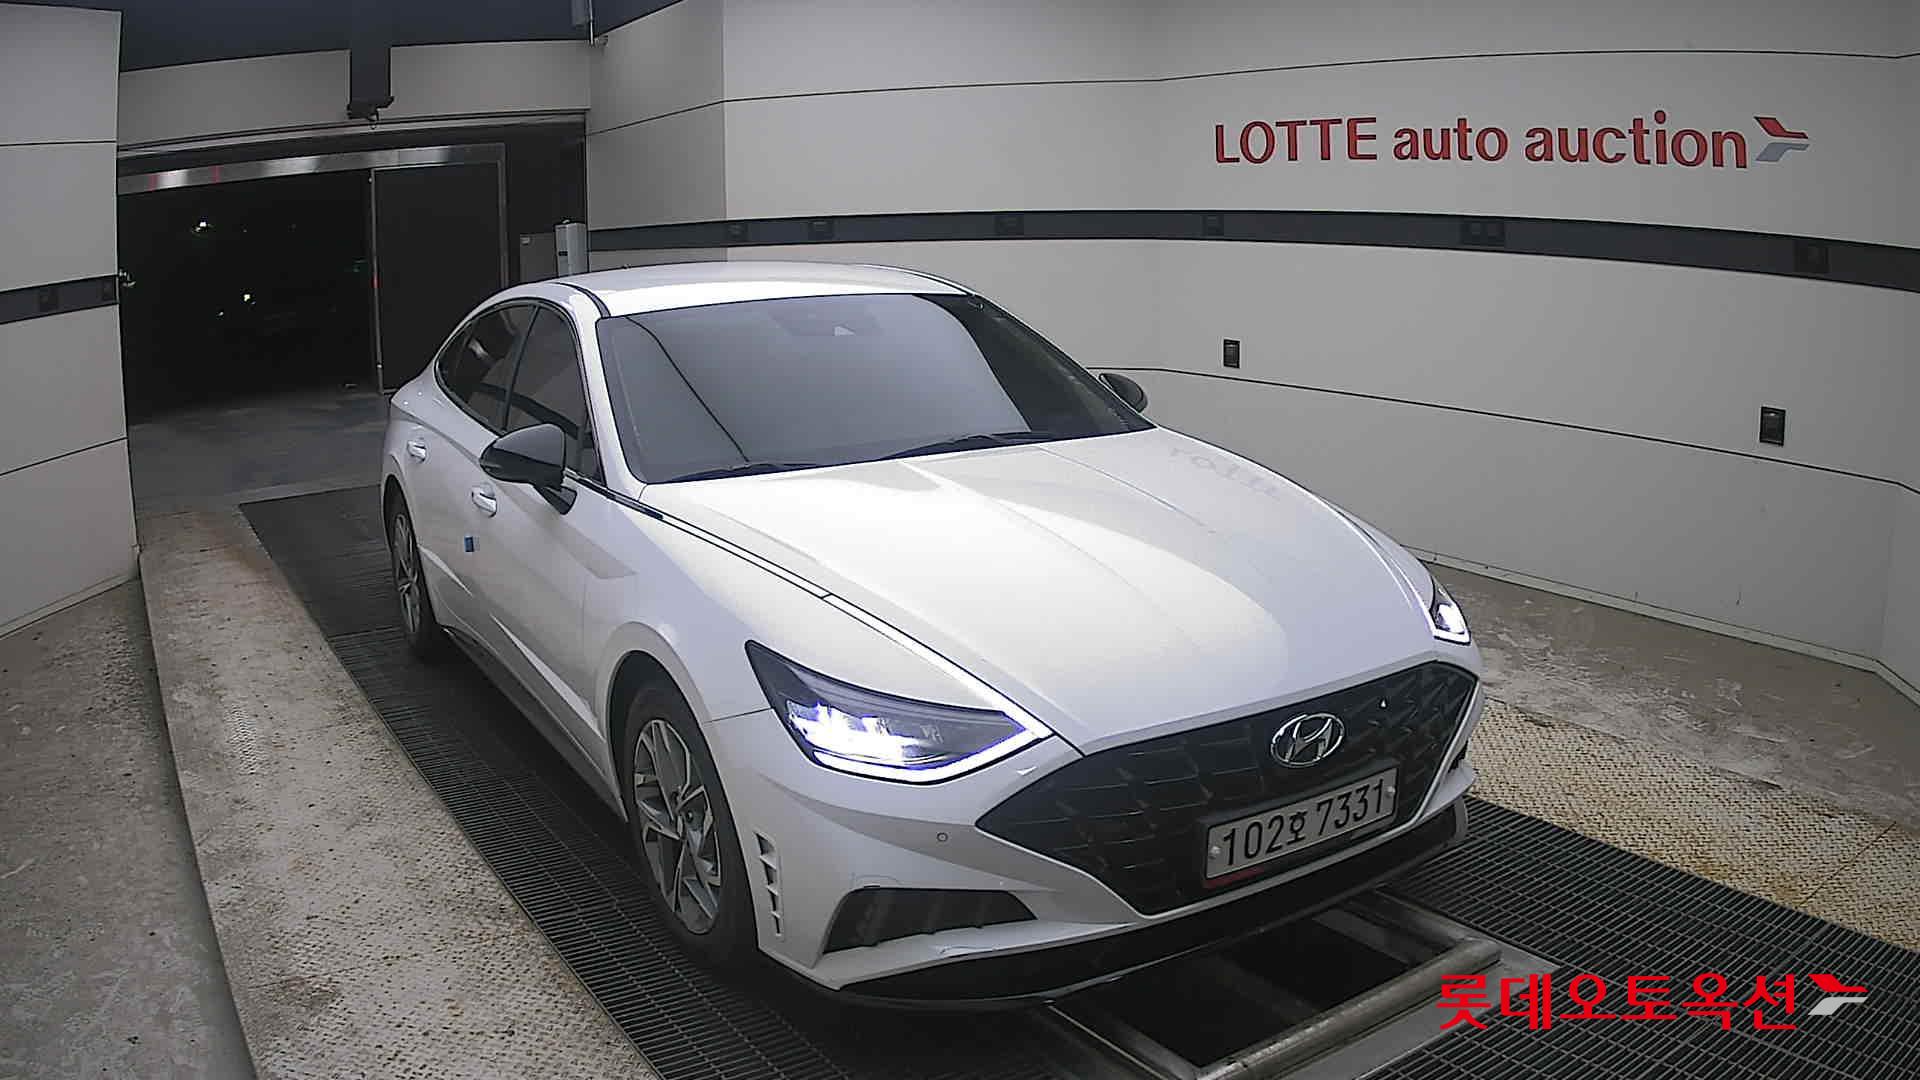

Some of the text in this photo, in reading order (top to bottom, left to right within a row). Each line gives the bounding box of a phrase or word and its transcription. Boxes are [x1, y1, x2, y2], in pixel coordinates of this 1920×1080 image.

[1215, 109, 1748, 169] LOTTE auto auction
[1223, 778, 1385, 866] 102호 7331
